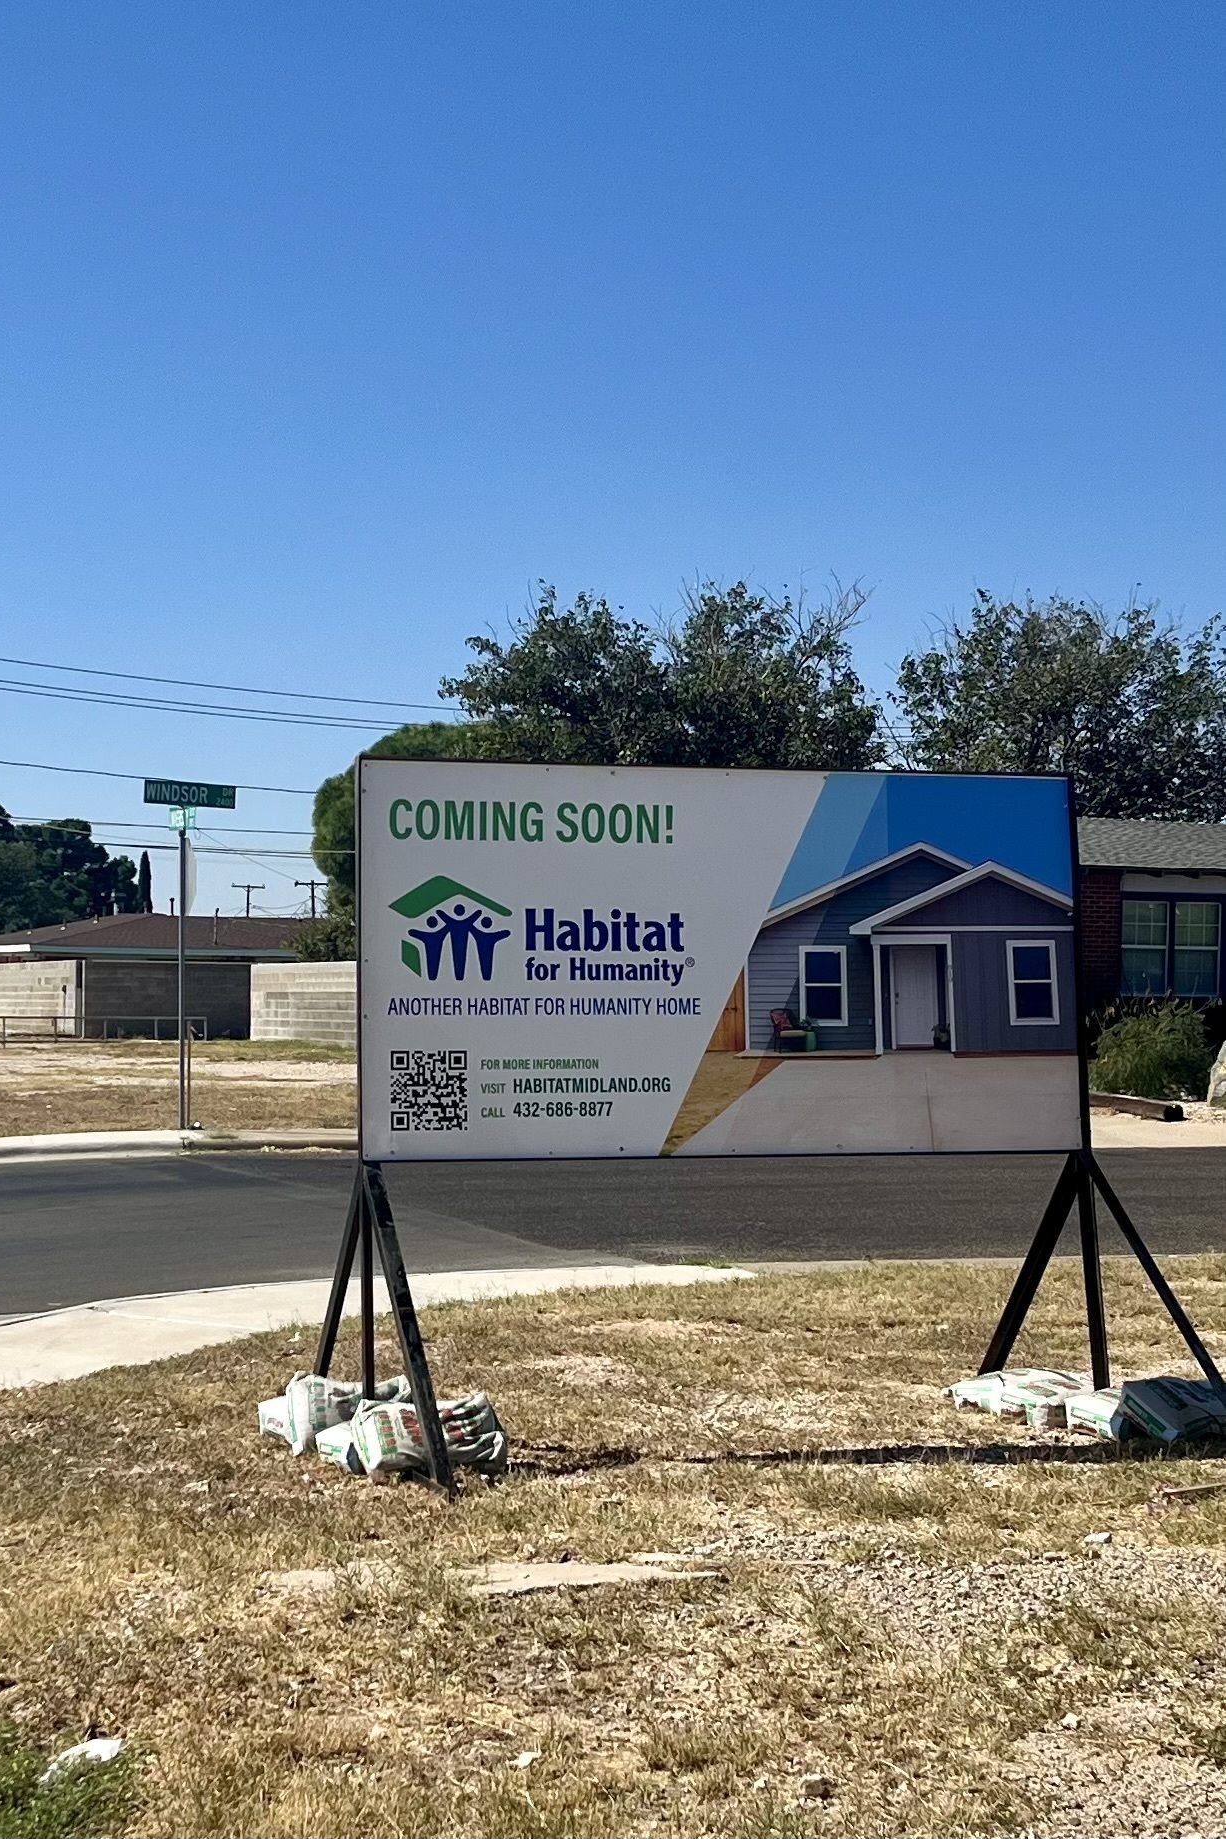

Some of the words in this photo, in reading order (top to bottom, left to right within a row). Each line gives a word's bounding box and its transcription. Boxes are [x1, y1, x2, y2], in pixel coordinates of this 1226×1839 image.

[146, 783, 208, 804] WINDSOR
[222, 787, 234, 797] DR
[389, 798, 543, 842] COMING
[556, 802, 674, 844] SOON!
[525, 908, 685, 952] Habitat
[525, 956, 561, 981] for
[388, 997, 463, 1016] ANOTHER
[467, 997, 531, 1016] HABITAT
[535, 997, 565, 1016] FOR
[571, 997, 652, 1016] HUMANITY
[656, 997, 701, 1016] HOME
[480, 1059, 501, 1070] FOR
[502, 1059, 531, 1070] MORE
[533, 1058, 599, 1070] INFORMATION
[480, 1083, 506, 1094] VISIT
[513, 1077, 671, 1094] HABITATMIDLAND.ORG
[480, 1107, 506, 1118] CALL
[512, 1101, 614, 1118] 432-686-8877
